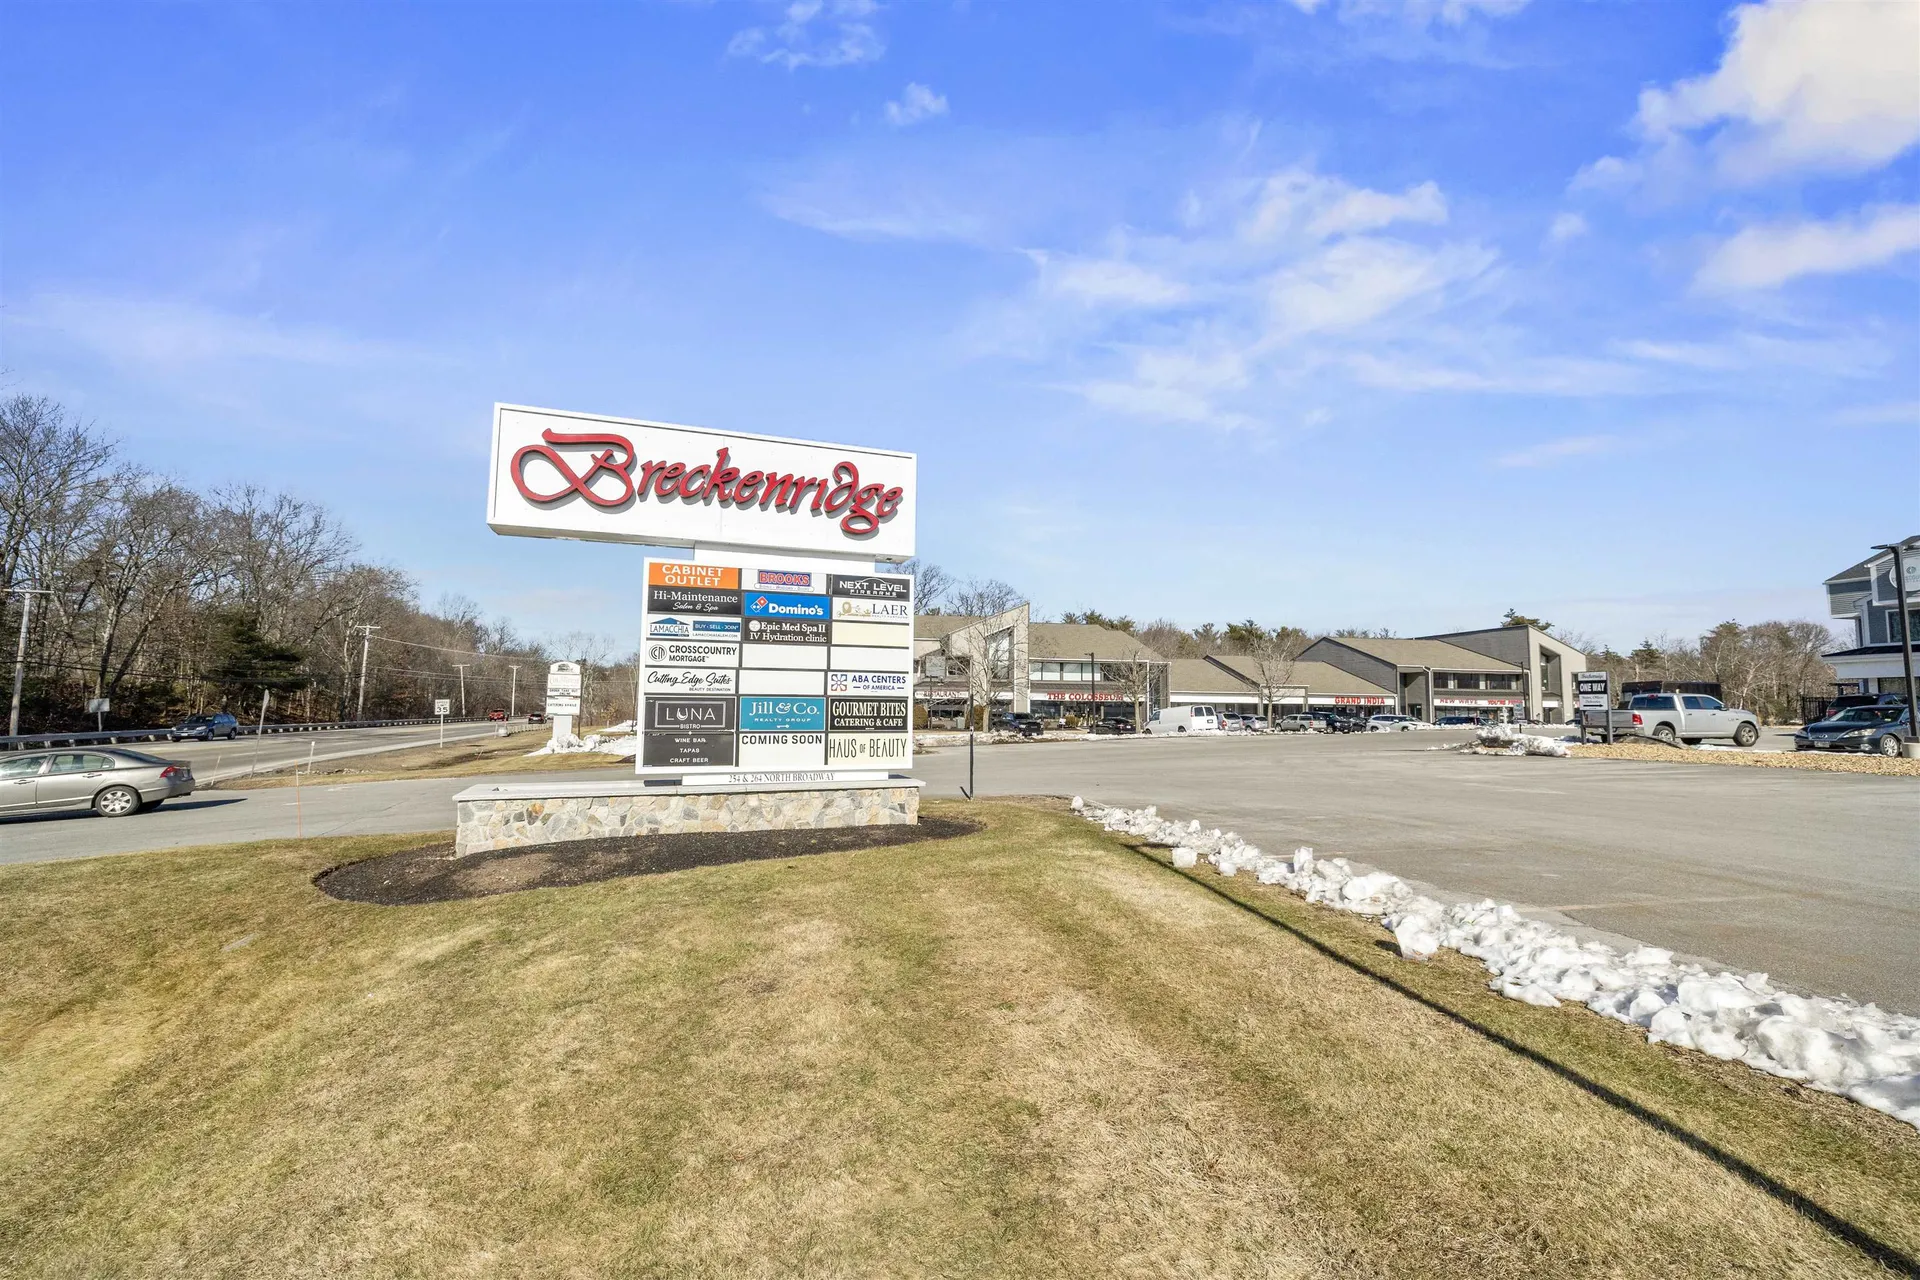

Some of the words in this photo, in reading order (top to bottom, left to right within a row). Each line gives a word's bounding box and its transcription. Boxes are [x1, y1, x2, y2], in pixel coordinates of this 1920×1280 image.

[510, 428, 903, 534] Breckenridge
[662, 565, 724, 577] CABINET
[665, 575, 721, 586] OUTLET
[759, 572, 810, 586] BROOKS
[840, 581, 869, 590] NEXT
[874, 583, 907, 592] LEVEL
[654, 590, 738, 603] Hi-Maintenance
[703, 603, 719, 612] Spa
[768, 603, 824, 615] Domino's
[872, 604, 908, 616] LAER
[650, 625, 690, 633] LAMACCHIA
[761, 622, 780, 632] Epic
[782, 623, 800, 631] Med
[801, 624, 817, 634] Spa
[818, 624, 826, 632] II
[750, 632, 761, 640] IV
[762, 633, 804, 642] Hydration
[805, 634, 827, 642] clinic
[669, 645, 737, 655] CROSSCOUNTRY
[647, 671, 678, 686] Cutting
[682, 671, 704, 687] Edge
[706, 672, 732, 686] Suites
[852, 675, 870, 683] ABA
[871, 675, 906, 684] CENTERS
[1580, 683, 1591, 691] ONE
[1592, 683, 1605, 691] WAY
[1335, 696, 1361, 704] GRAND
[1364, 696, 1385, 704] INDIA
[666, 708, 716, 720] LUNA
[749, 701, 773, 716] Jill
[775, 703, 791, 714] &
[793, 702, 820, 714] Co.
[832, 701, 878, 716] GOURMET
[880, 702, 906, 717] BITES
[834, 718, 875, 726] CATERING
[876, 718, 882, 726] &
[883, 718, 903, 726] CAFE
[741, 735, 788, 744] COMING
[792, 735, 822, 744] SOON
[860, 744, 866, 753] OF
[743, 774, 749, 782] &
[764, 773, 791, 782] NORTH
[793, 772, 835, 781] BROADWAY
